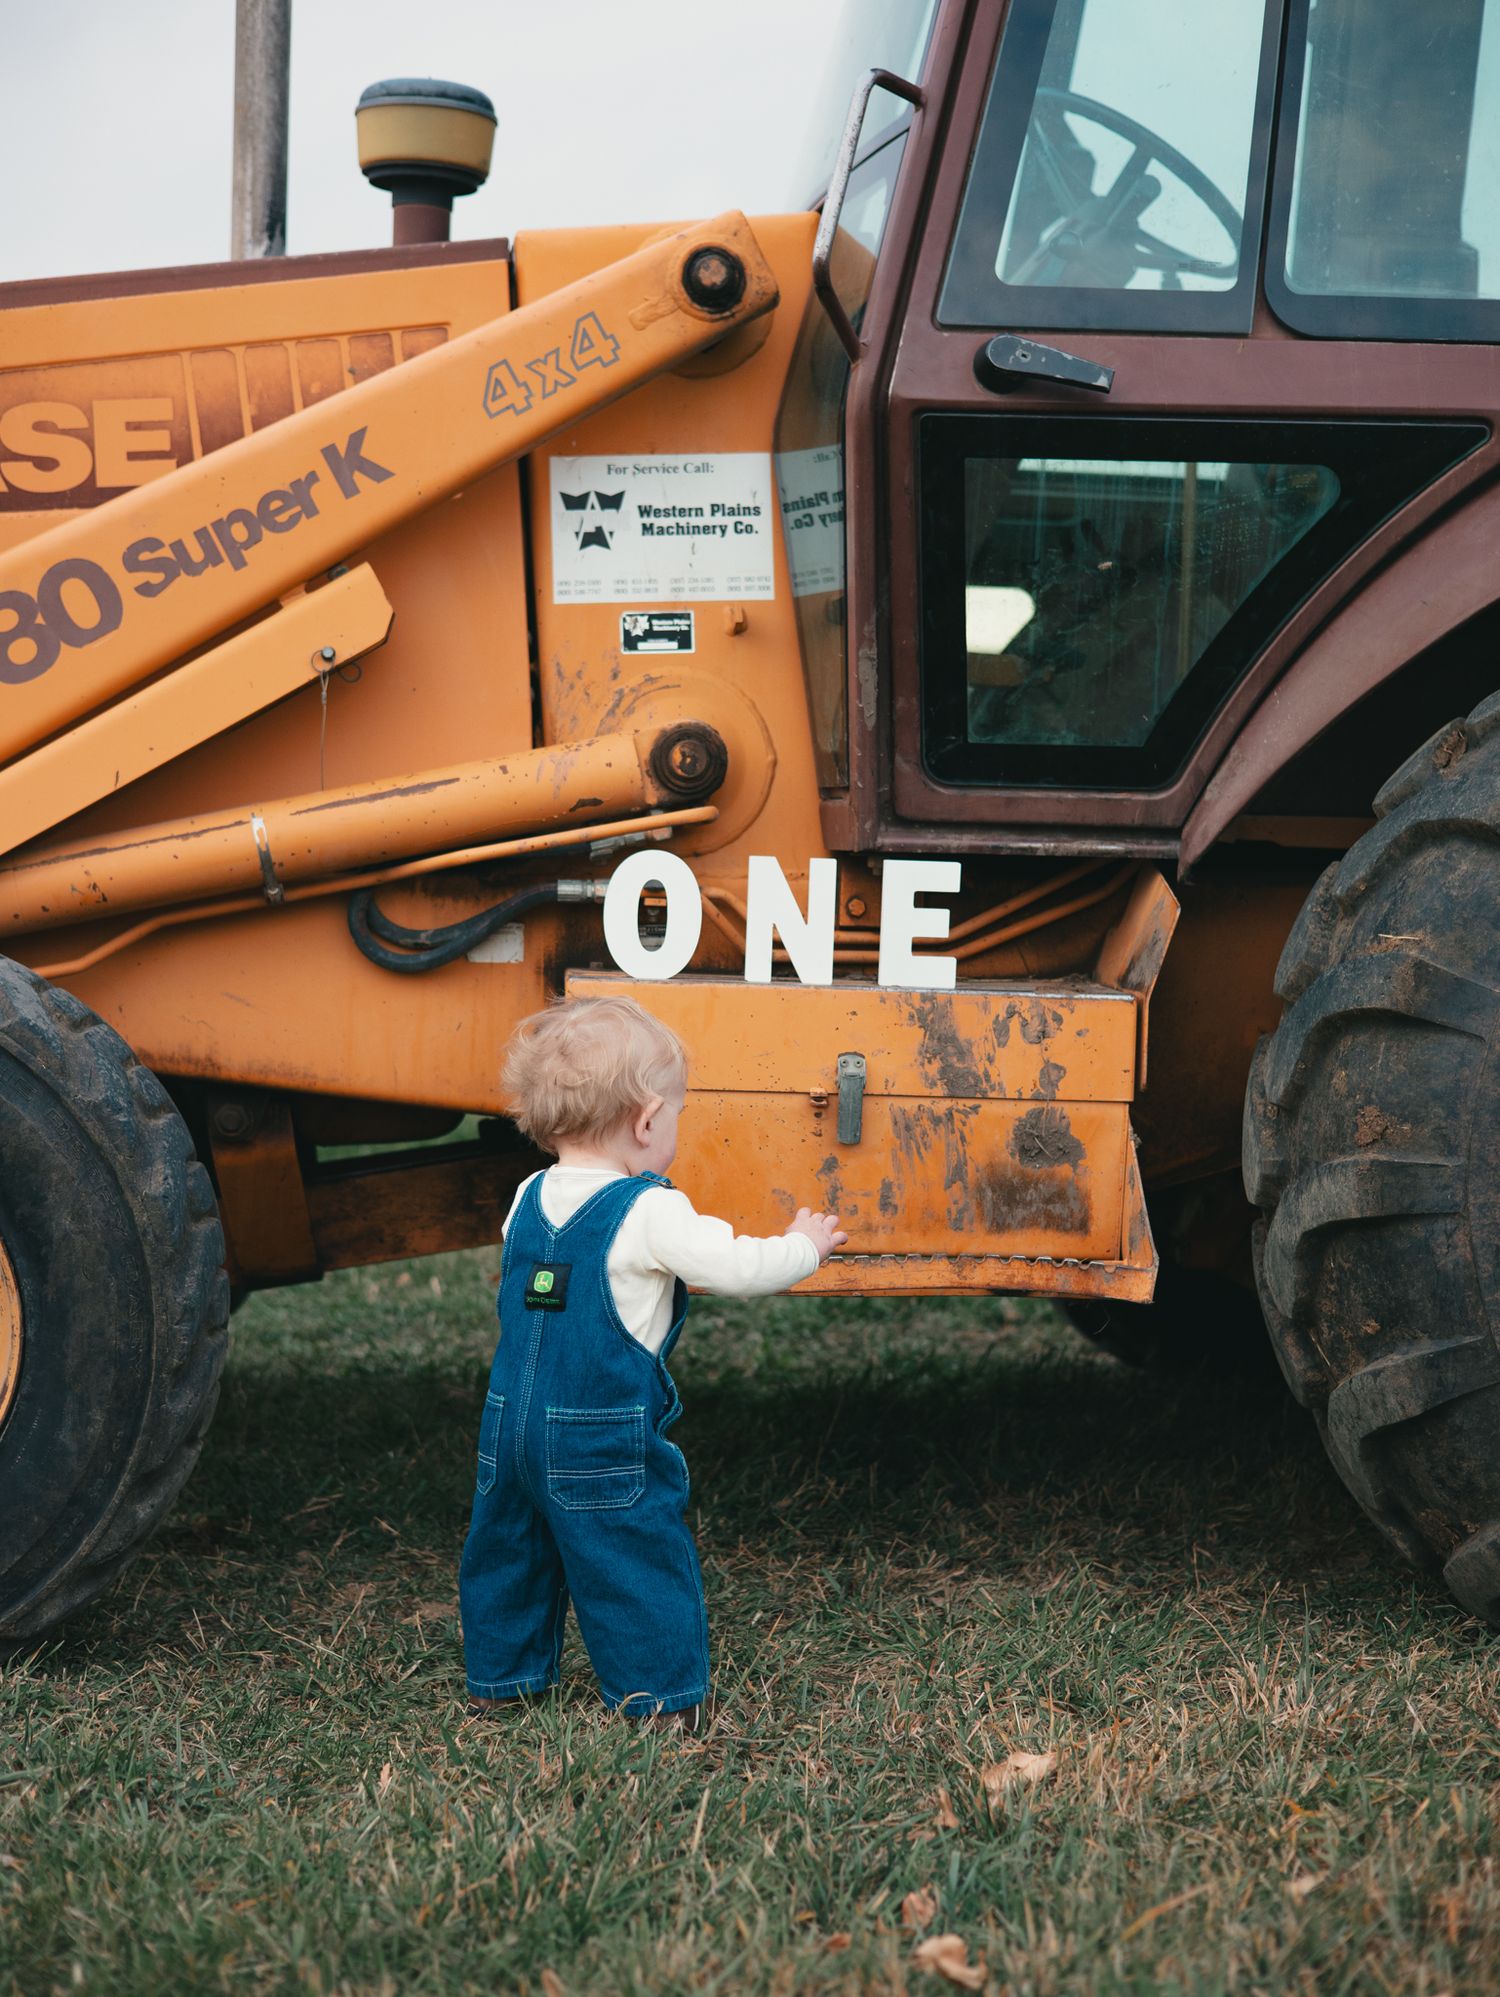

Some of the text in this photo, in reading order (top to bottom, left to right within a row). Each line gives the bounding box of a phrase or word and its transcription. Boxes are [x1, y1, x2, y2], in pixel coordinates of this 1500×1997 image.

[482, 311, 620, 419] 4x4
[0, 397, 177, 493] SE
[607, 462, 715, 476] For Service Call:
[122, 470, 321, 598] Super
[321, 425, 396, 500] K
[637, 503, 761, 519] Western Plains
[641, 521, 759, 538] Machinery Co.
[603, 849, 962, 989] ONE
